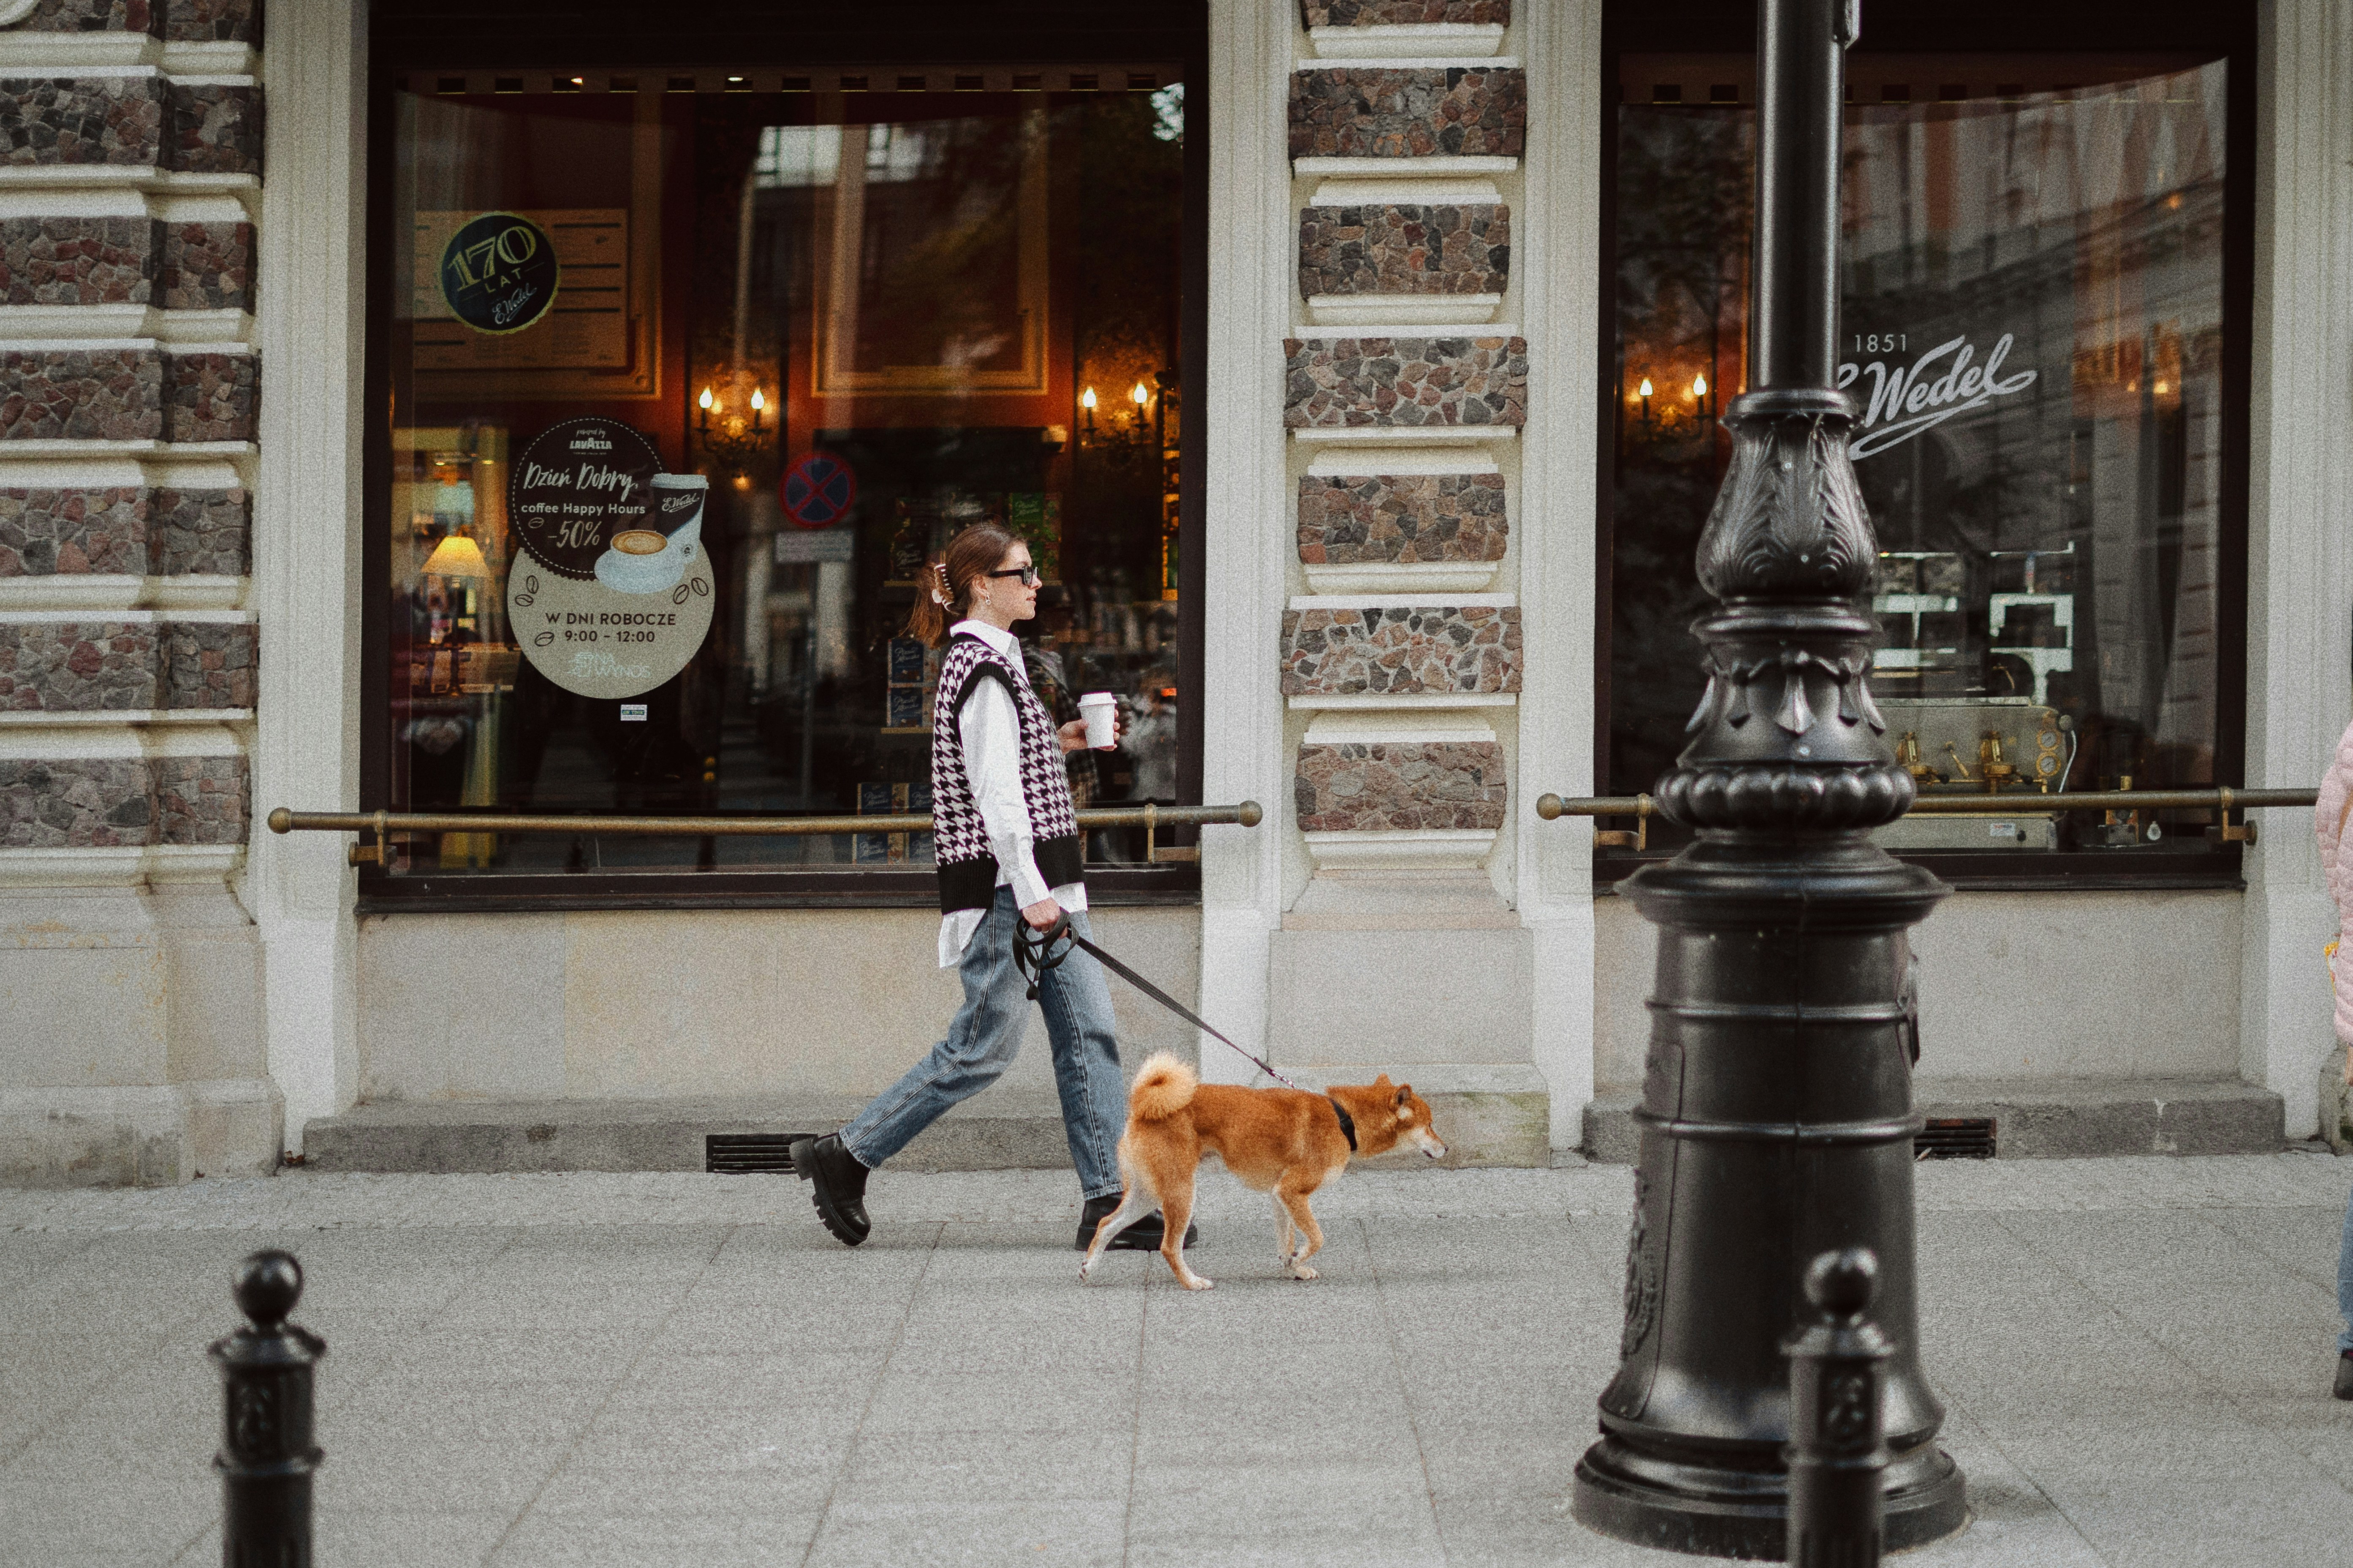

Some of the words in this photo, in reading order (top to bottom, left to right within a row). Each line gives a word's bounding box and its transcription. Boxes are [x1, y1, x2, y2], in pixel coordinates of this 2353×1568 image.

[448, 226, 537, 291] 170
[484, 268, 522, 293] LAT
[1855, 334, 1907, 353] 1851
[569, 438, 612, 449] LAVAZZA
[523, 462, 572, 489] Dzień
[521, 502, 558, 514] coffee
[563, 503, 604, 516] Happy
[608, 503, 645, 514] Hours
[546, 613, 561, 624] W
[567, 613, 594, 624] DNI
[600, 613, 676, 625] ROBOCZE
[565, 630, 598, 642] 9:00
[617, 631, 655, 642] 12:00
